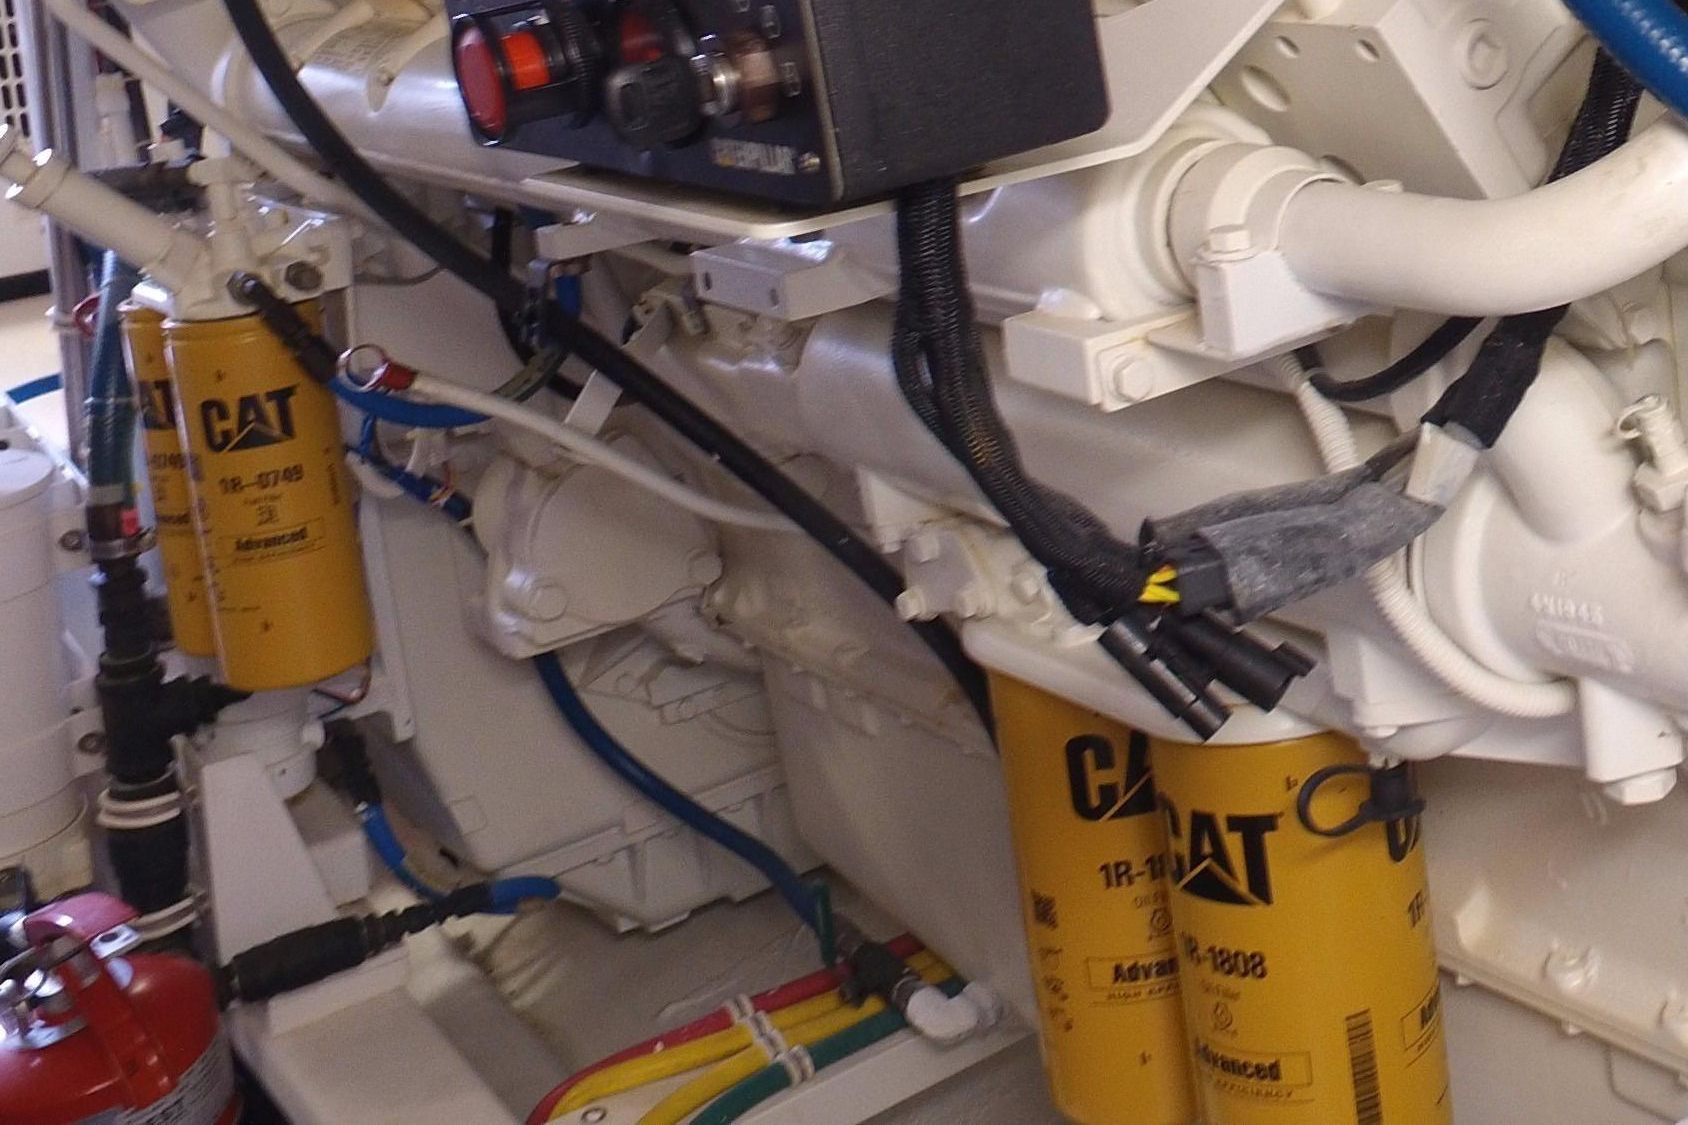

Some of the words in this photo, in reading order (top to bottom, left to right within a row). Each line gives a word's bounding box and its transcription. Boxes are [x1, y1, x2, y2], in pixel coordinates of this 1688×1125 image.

[201, 383, 299, 453] CAT
[1066, 729, 1157, 820] CA
[1113, 956, 1180, 984] Advan
[1181, 931, 1268, 979] R-1808
